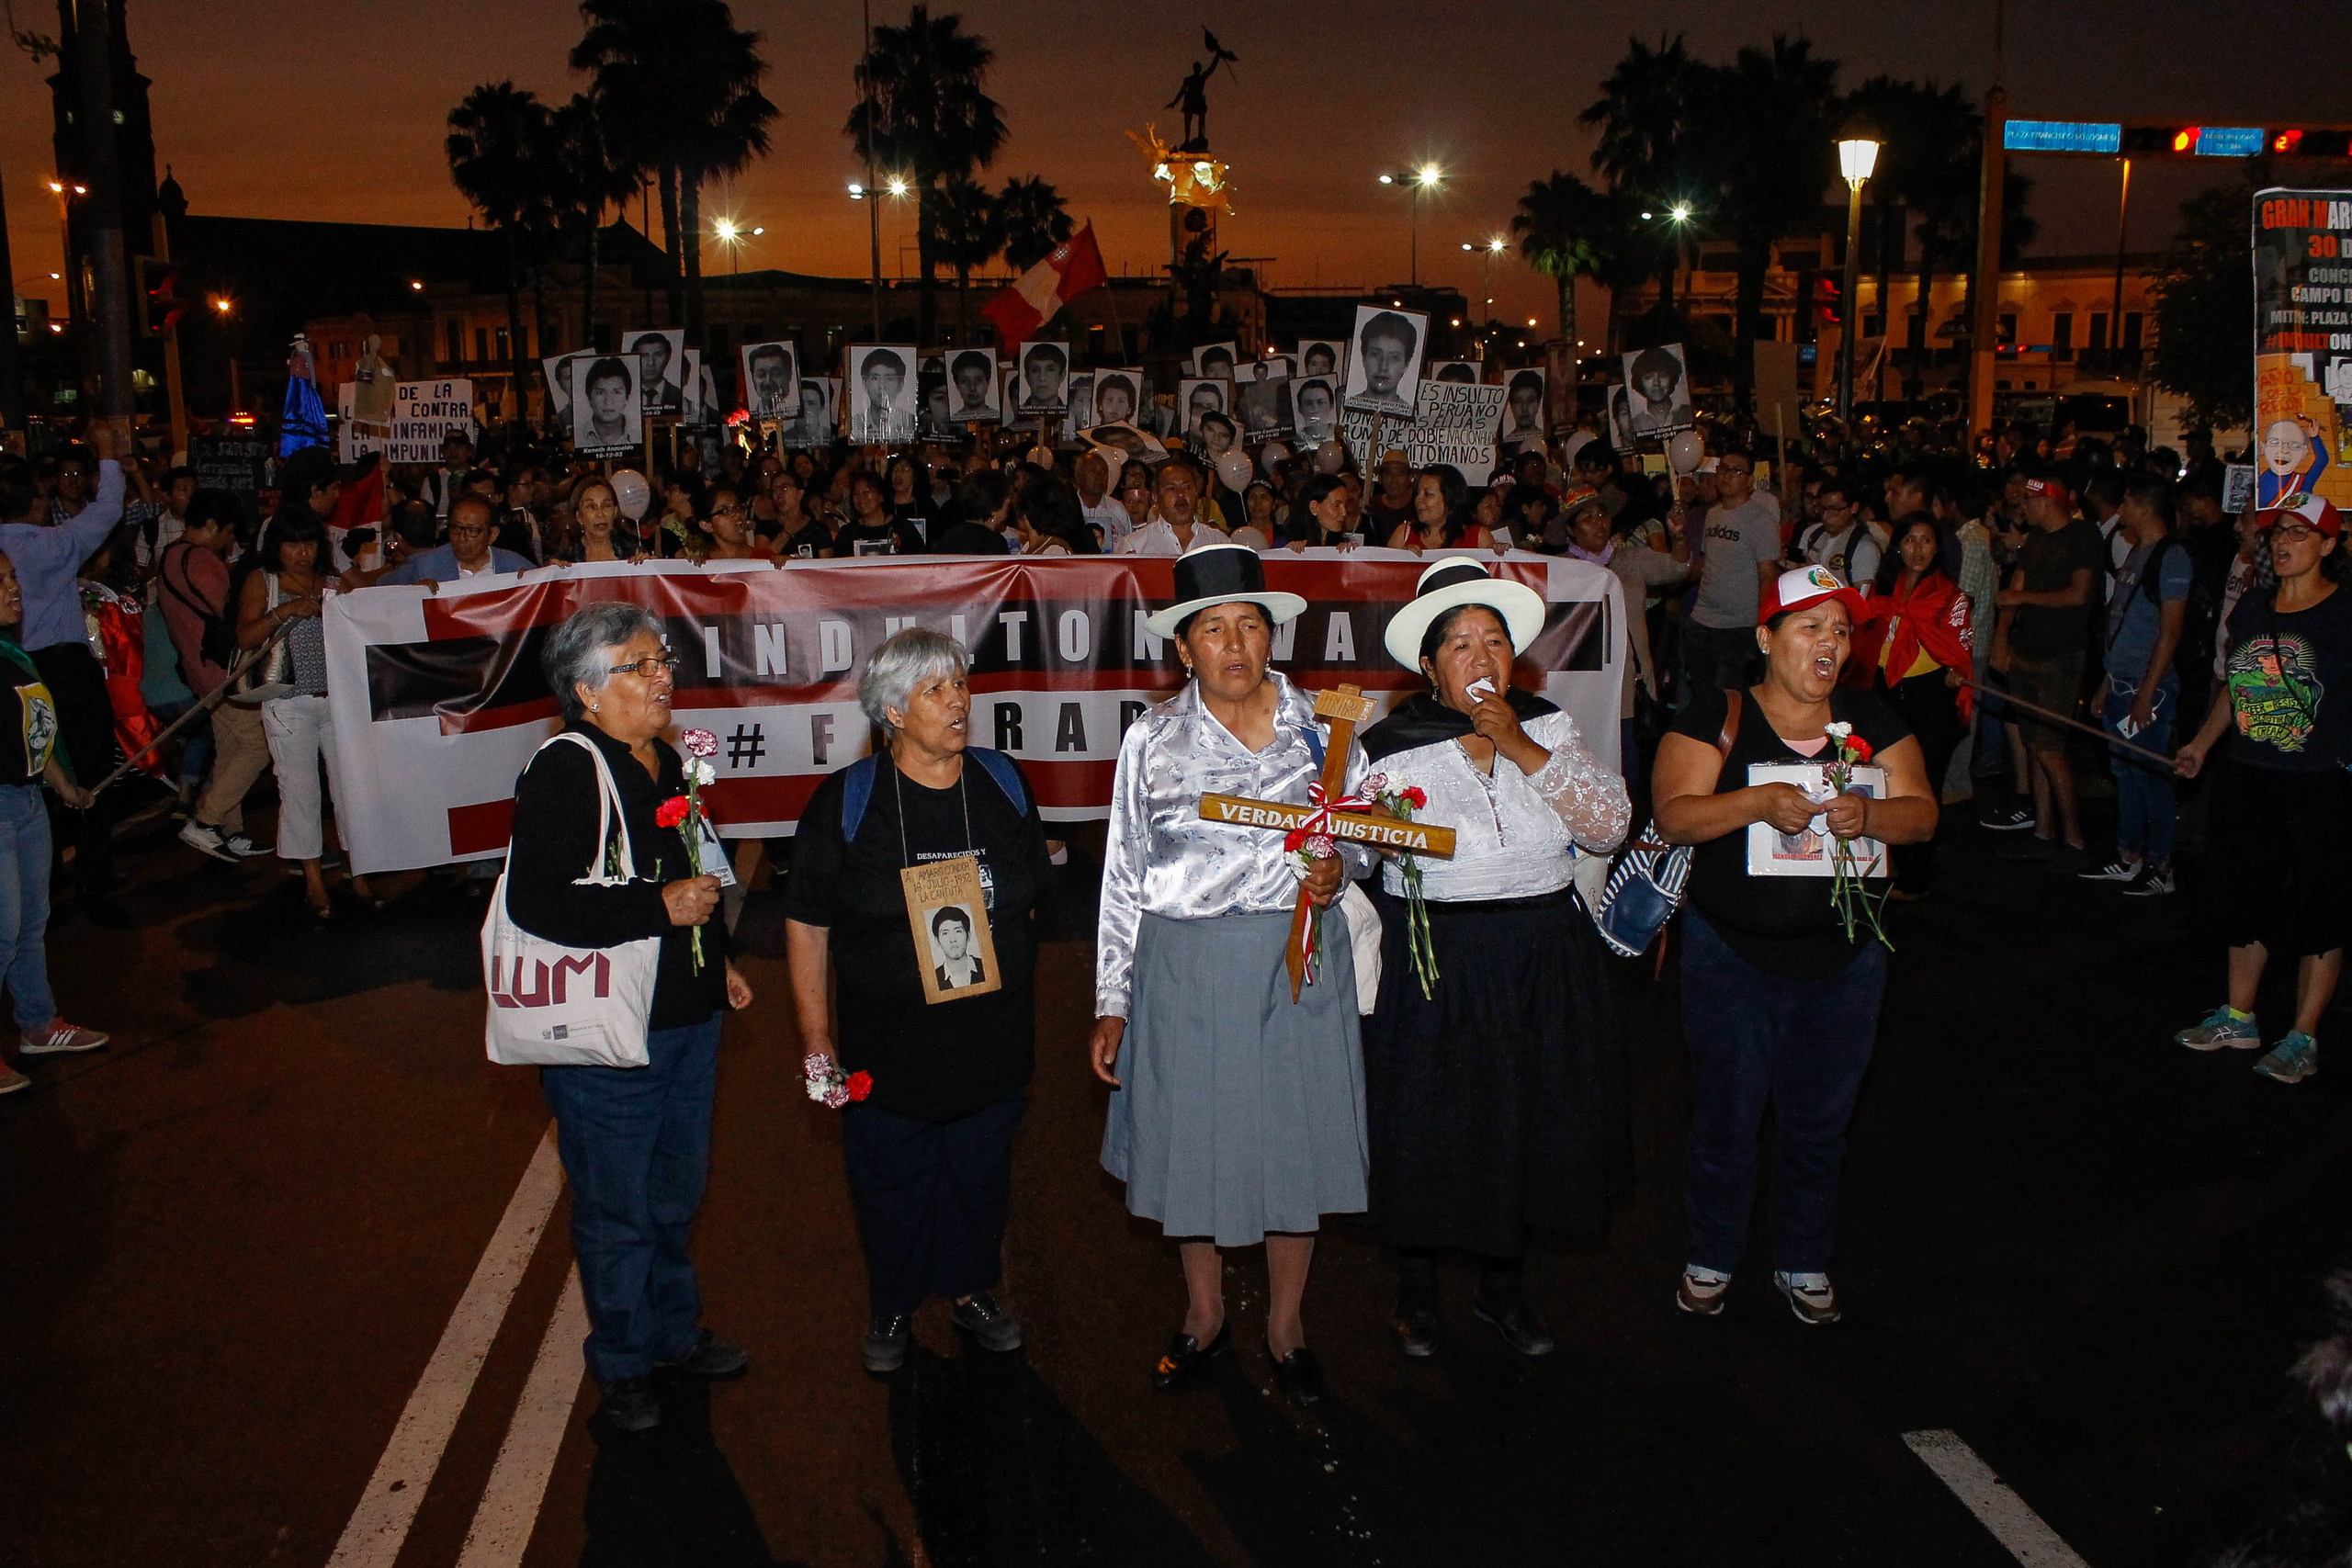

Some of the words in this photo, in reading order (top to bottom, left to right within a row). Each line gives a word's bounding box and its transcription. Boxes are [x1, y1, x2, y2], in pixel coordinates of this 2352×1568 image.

[2262, 199, 2310, 230] GRAN
[2312, 200, 2352, 230] MAR
[2308, 235, 2337, 258] 30
[2291, 287, 2341, 303] CAMPO
[2311, 311, 2348, 325] PLAZA
[2265, 332, 2352, 351] #INDULTON
[399, 386, 419, 401] DE
[434, 382, 451, 399] LA
[1420, 383, 1441, 401] ES
[1442, 386, 1505, 404] INSULTO
[411, 401, 468, 419] CONTRA
[1429, 401, 1498, 418] PERUANO
[1432, 415, 1486, 429] ELIJAS
[351, 423, 370, 441] LA
[1388, 429, 1403, 443] DE
[351, 444, 368, 460] LA
[1403, 444, 1489, 464] MITOMANOS
[1705, 524, 1740, 542] adidas
[2239, 696, 2266, 714] CREER
[2256, 726, 2284, 737] CREAR
[1329, 820, 1429, 850] JUSTICIA
[916, 850, 979, 860] DESAPARECIDOS
[920, 891, 929, 903] LA
[930, 886, 963, 901] CANTUTA
[491, 950, 610, 1009] LUM
